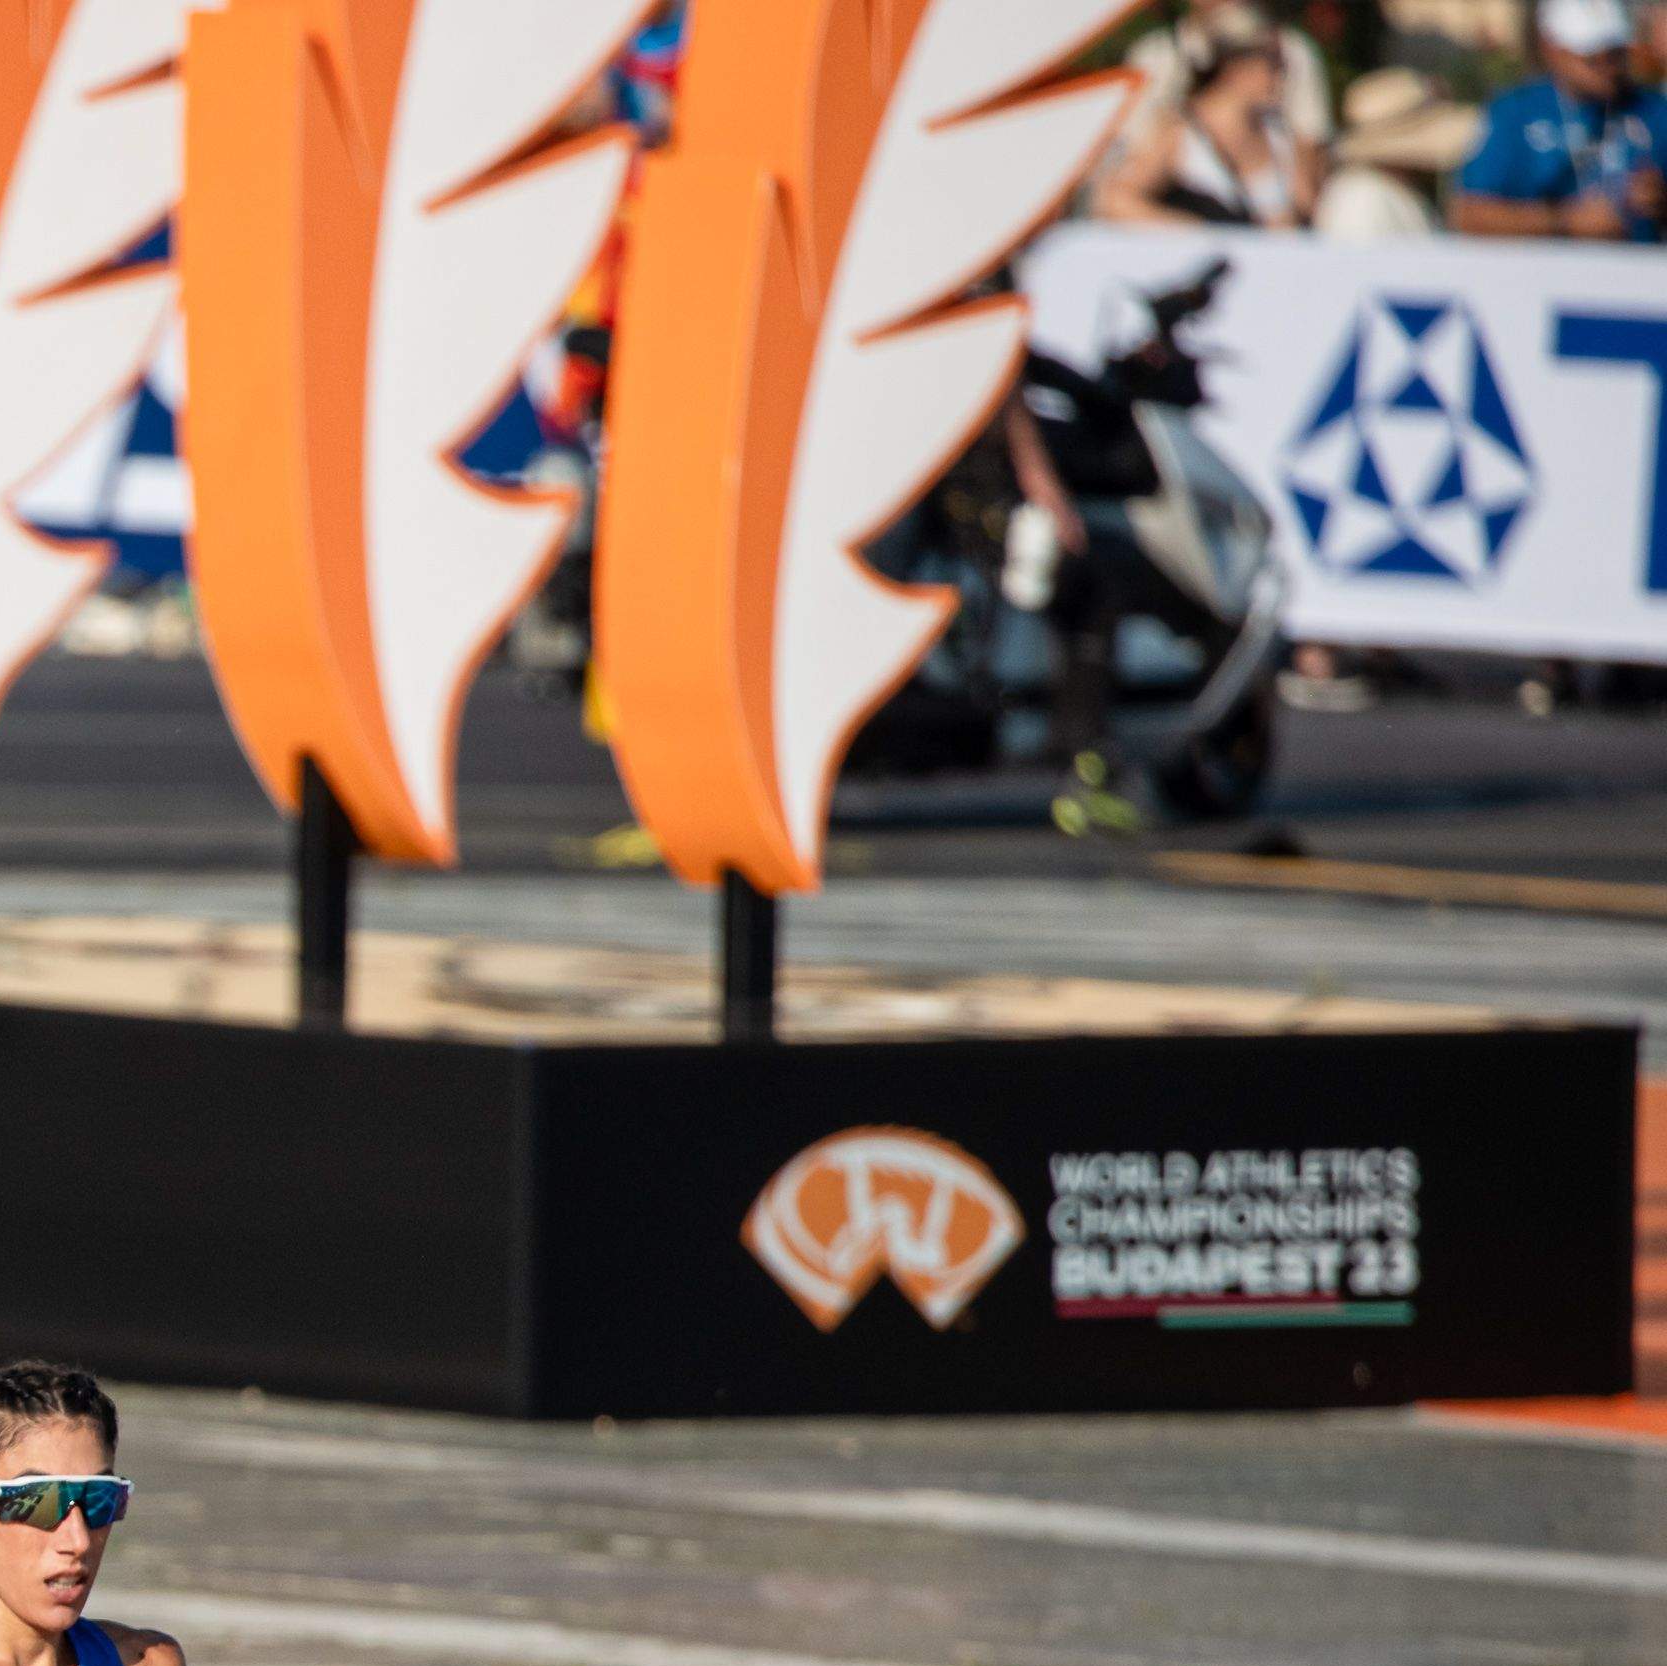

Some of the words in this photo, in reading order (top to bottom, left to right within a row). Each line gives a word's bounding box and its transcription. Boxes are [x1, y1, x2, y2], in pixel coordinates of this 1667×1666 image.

[1049, 1152, 1199, 1192] WORLD
[1201, 1148, 1418, 1190] ATHLETICS
[1048, 1196, 1418, 1241] CHAMPIONSHIPS
[1053, 1245, 1341, 1295] BUDAPEST
[1349, 1240, 1418, 1294] 23
